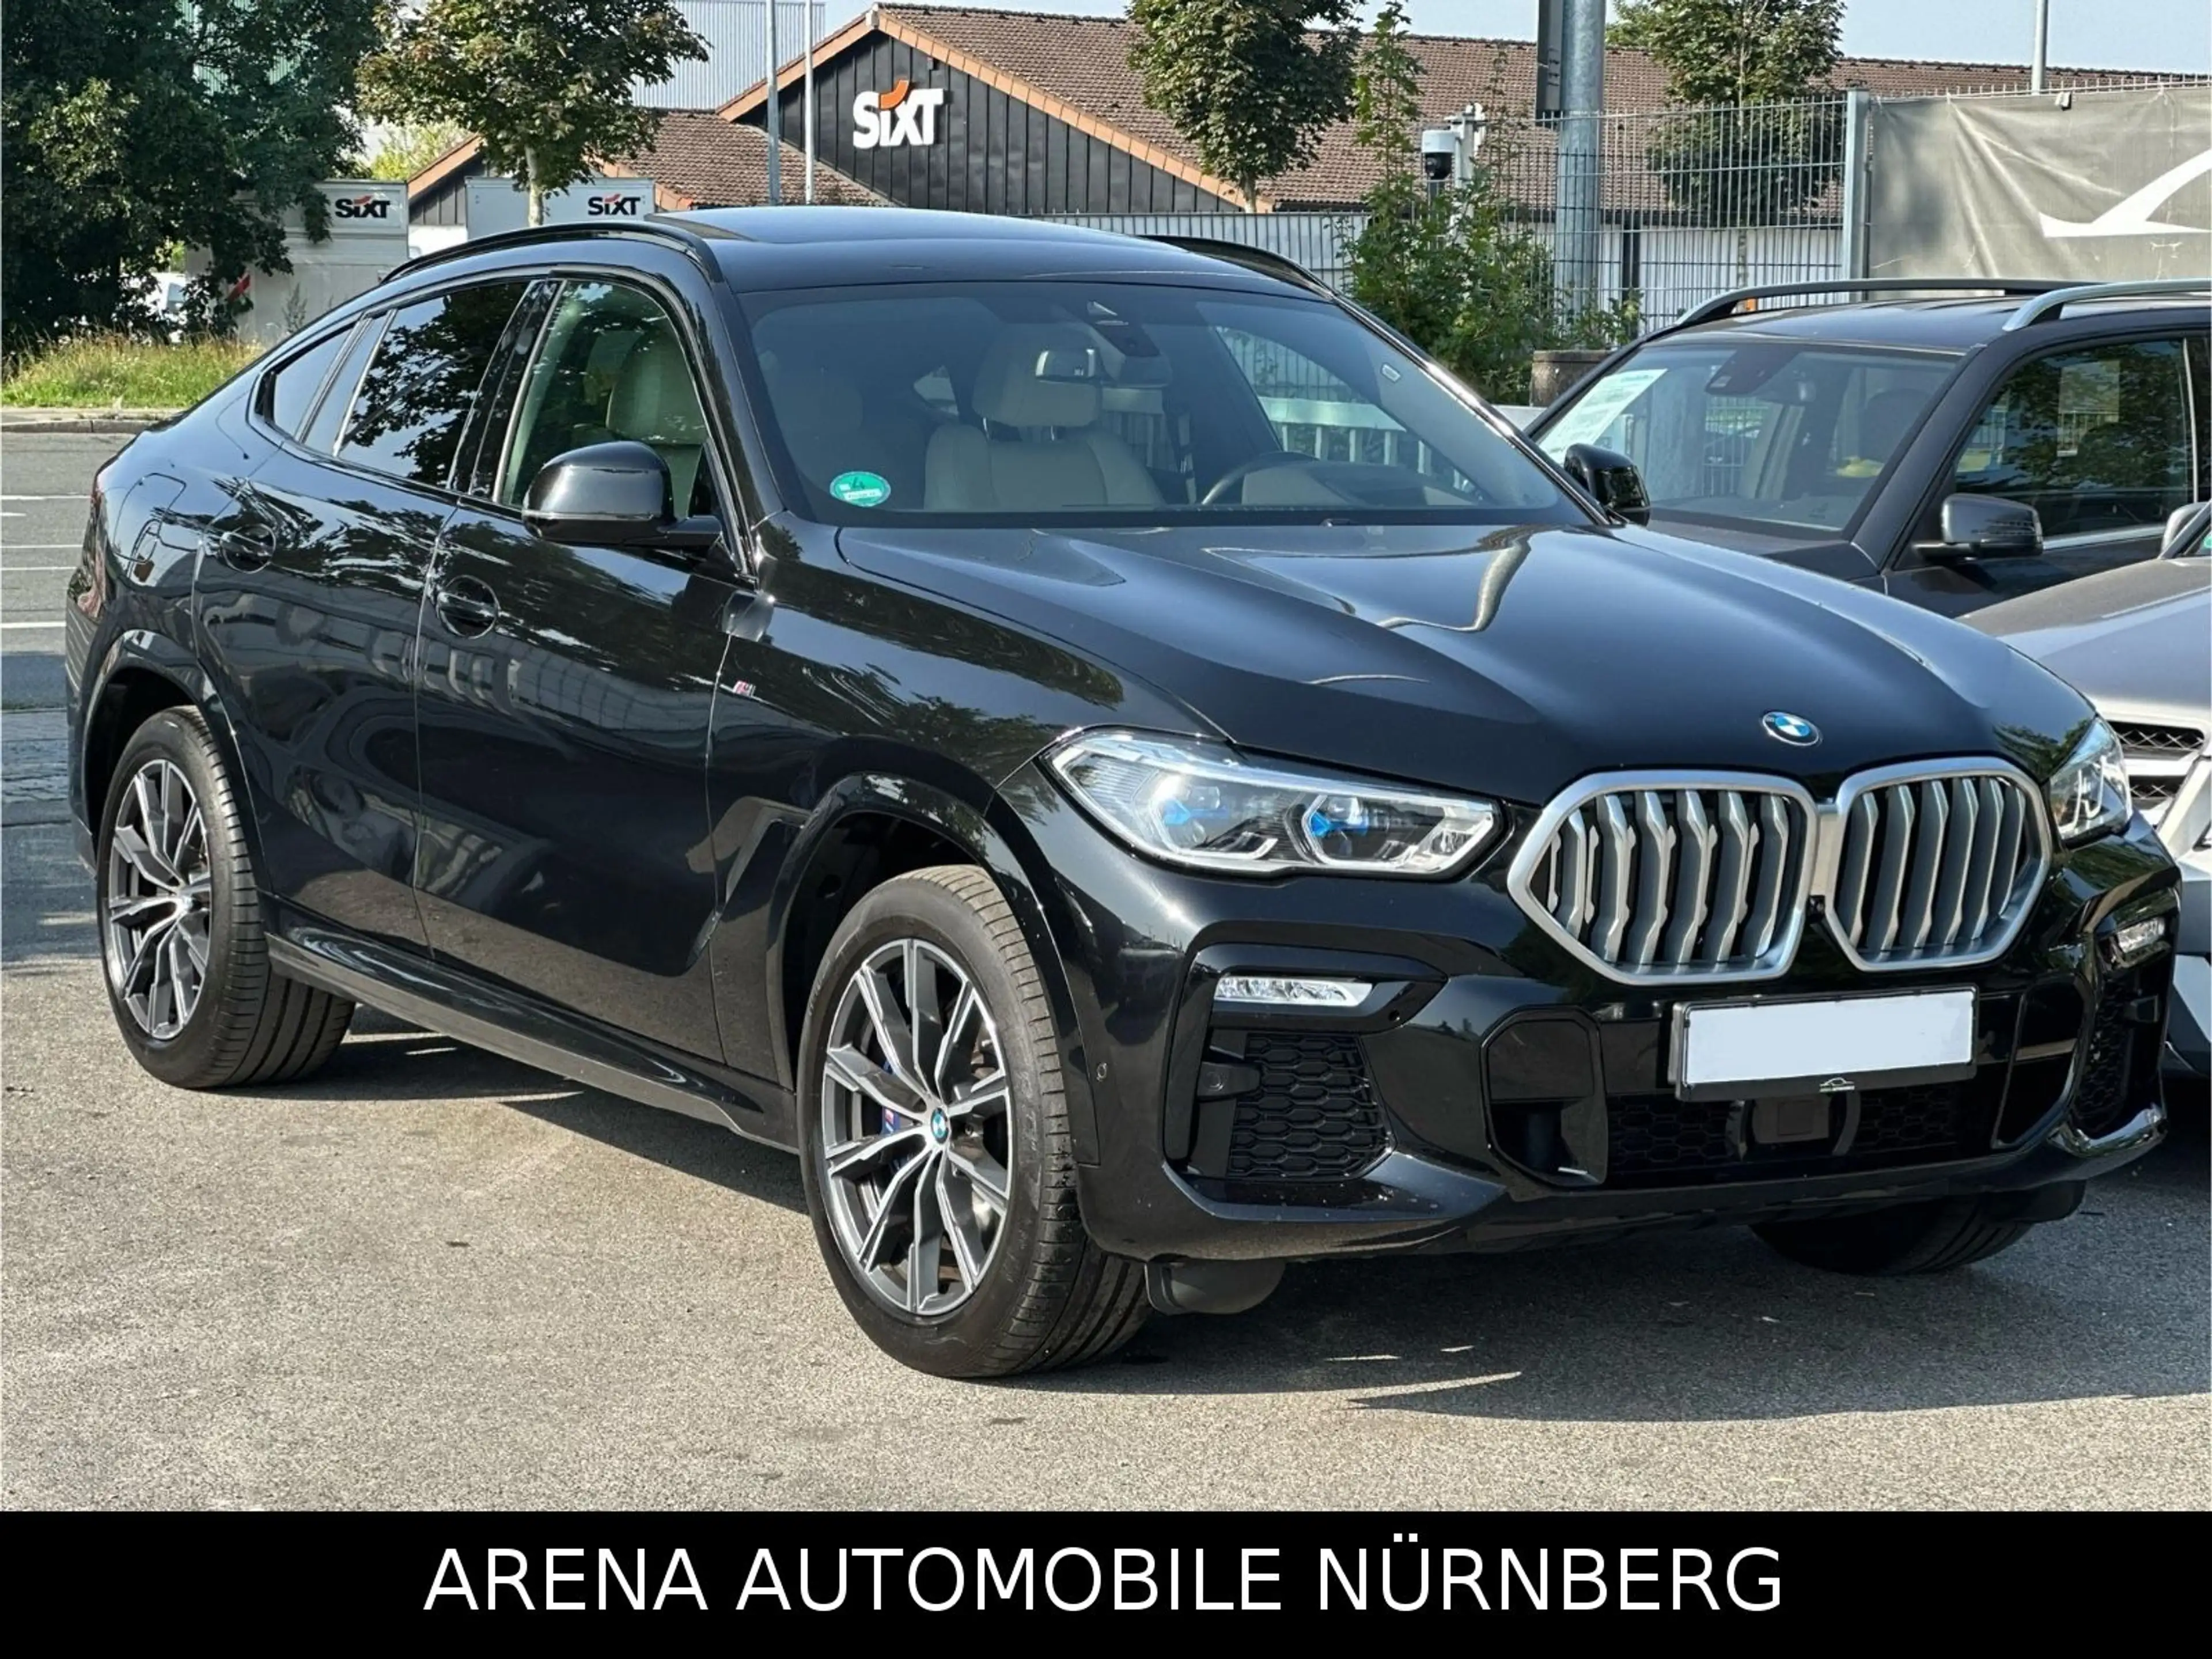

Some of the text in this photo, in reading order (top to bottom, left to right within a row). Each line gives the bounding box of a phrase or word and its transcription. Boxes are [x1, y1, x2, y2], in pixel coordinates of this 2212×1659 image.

[853, 79, 944, 149] SIXT
[335, 195, 391, 218] SIXT
[588, 194, 641, 215] SIXT
